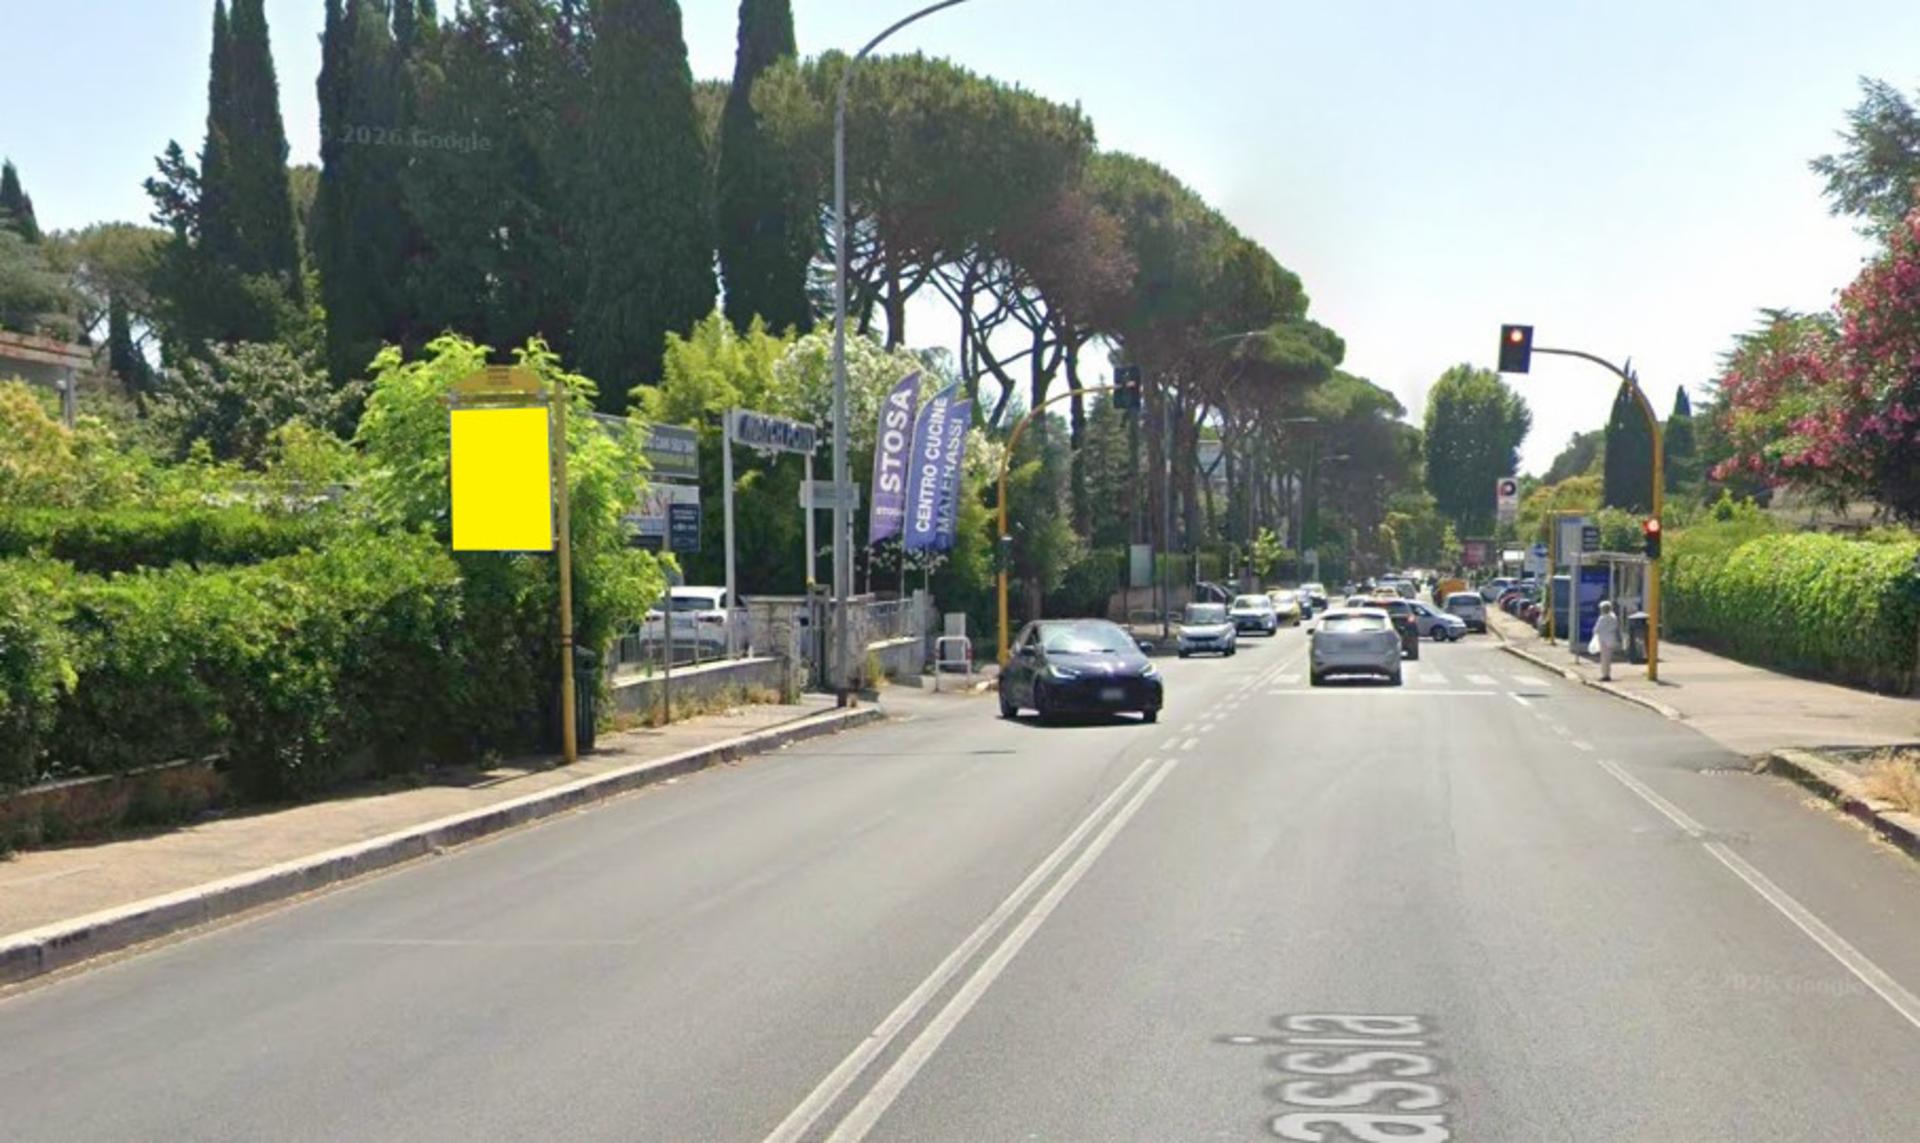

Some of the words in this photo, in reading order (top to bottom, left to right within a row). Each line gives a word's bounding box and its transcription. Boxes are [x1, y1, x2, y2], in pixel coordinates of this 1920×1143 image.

[880, 388, 913, 494] STOSA
[925, 397, 948, 460] CUCINE
[915, 464, 938, 532] CENTRO
